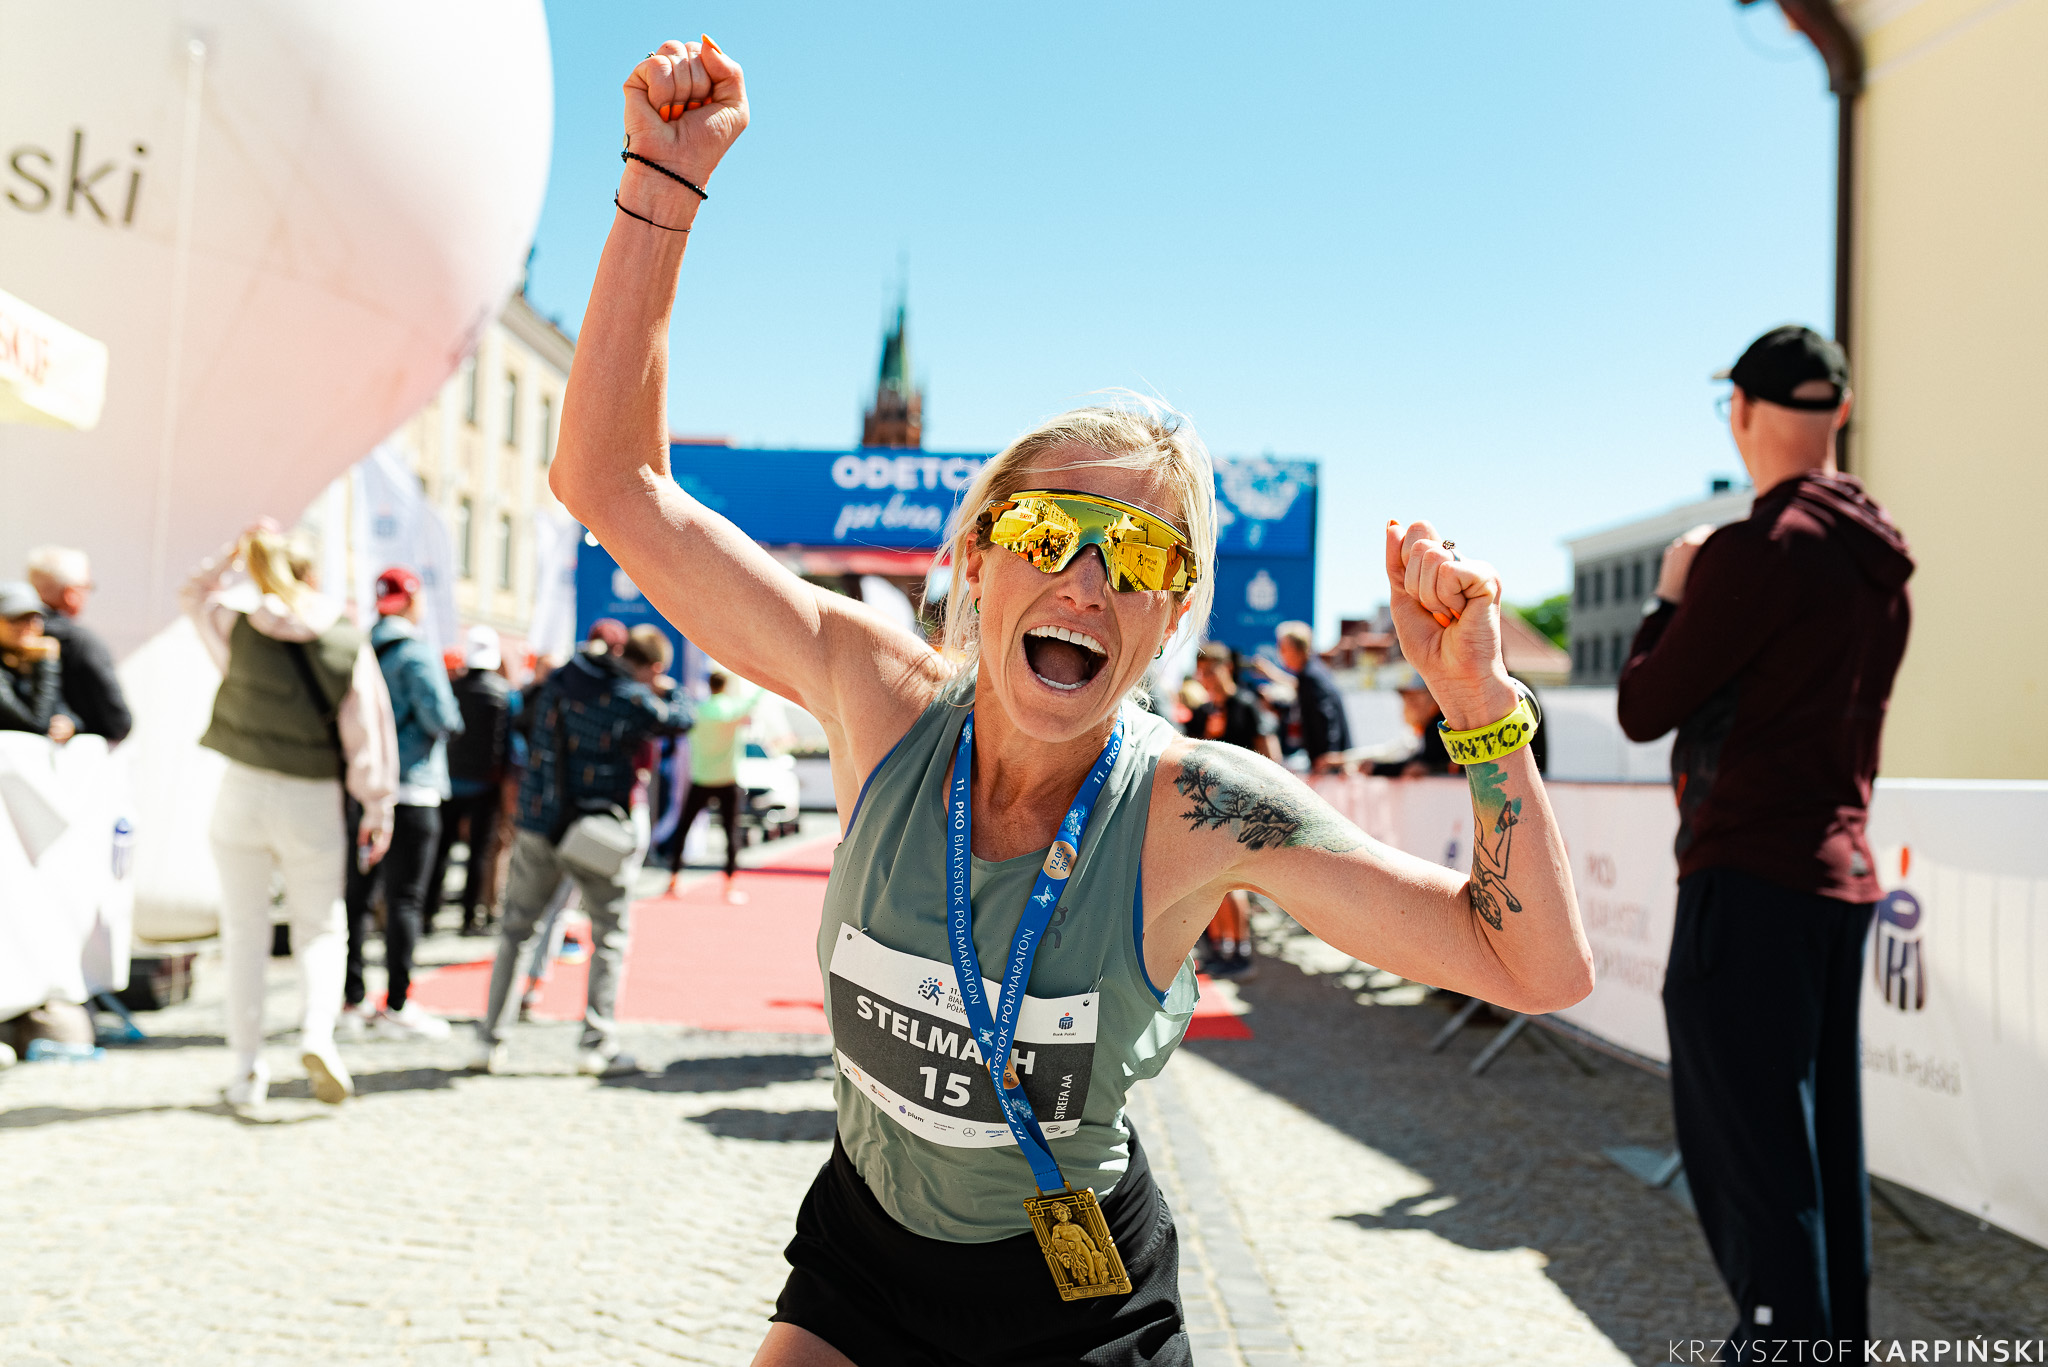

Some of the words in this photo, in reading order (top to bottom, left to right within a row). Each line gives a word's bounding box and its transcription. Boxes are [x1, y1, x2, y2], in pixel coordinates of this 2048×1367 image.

[7, 128, 149, 229] ski
[1105, 740, 1121, 767] PKO
[955, 777, 965, 797] 11.
[954, 801, 965, 830] PKO
[953, 834, 965, 905] BIAŁYSTOK
[1060, 853, 1072, 872] 2024
[954, 910, 981, 1005] PÓŁMARATON
[1001, 928, 1035, 1025] PÓŁMARATON
[948, 995, 963, 1006] BIAŁ
[856, 994, 1036, 1075] STELMAH
[919, 1066, 972, 1108] 15
[1061, 1073, 1073, 1089] AA
[907, 1111, 925, 1123] plum
[1054, 1089, 1071, 1120] STREFA
